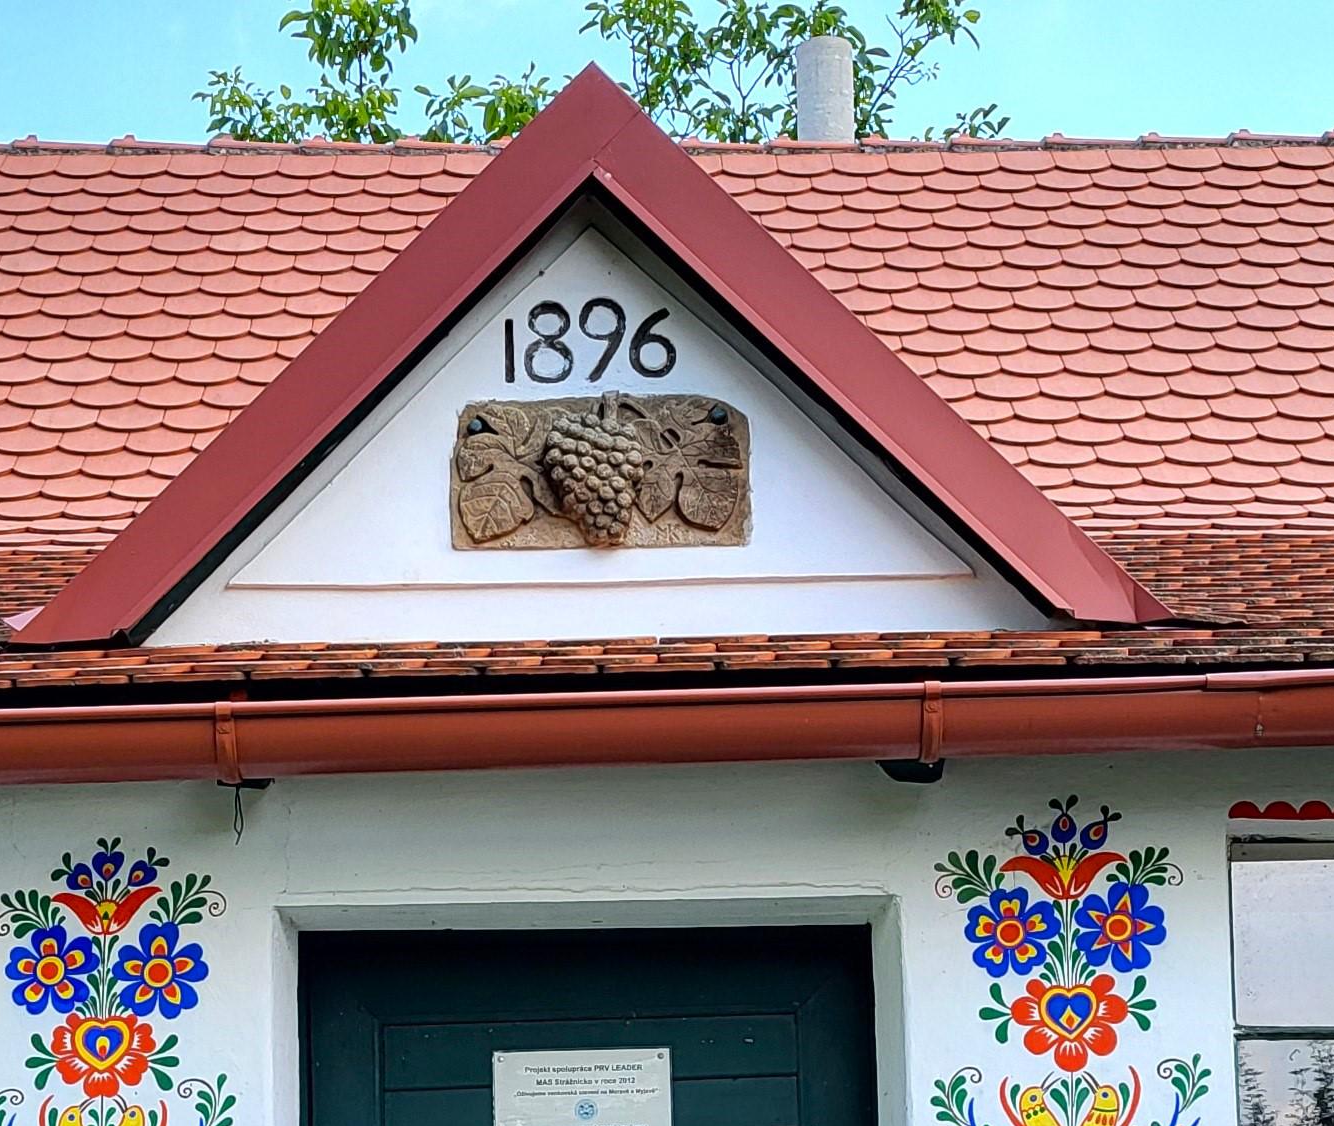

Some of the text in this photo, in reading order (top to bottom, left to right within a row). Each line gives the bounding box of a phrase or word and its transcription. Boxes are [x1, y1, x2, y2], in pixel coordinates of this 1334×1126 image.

[504, 297, 677, 384] 1896
[524, 1066, 551, 1074] Projekt
[552, 1065, 592, 1074] spolupráce
[611, 1063, 643, 1071] LEADER
[535, 1078, 553, 1086] MAS
[554, 1077, 593, 1086] Strážnicko
